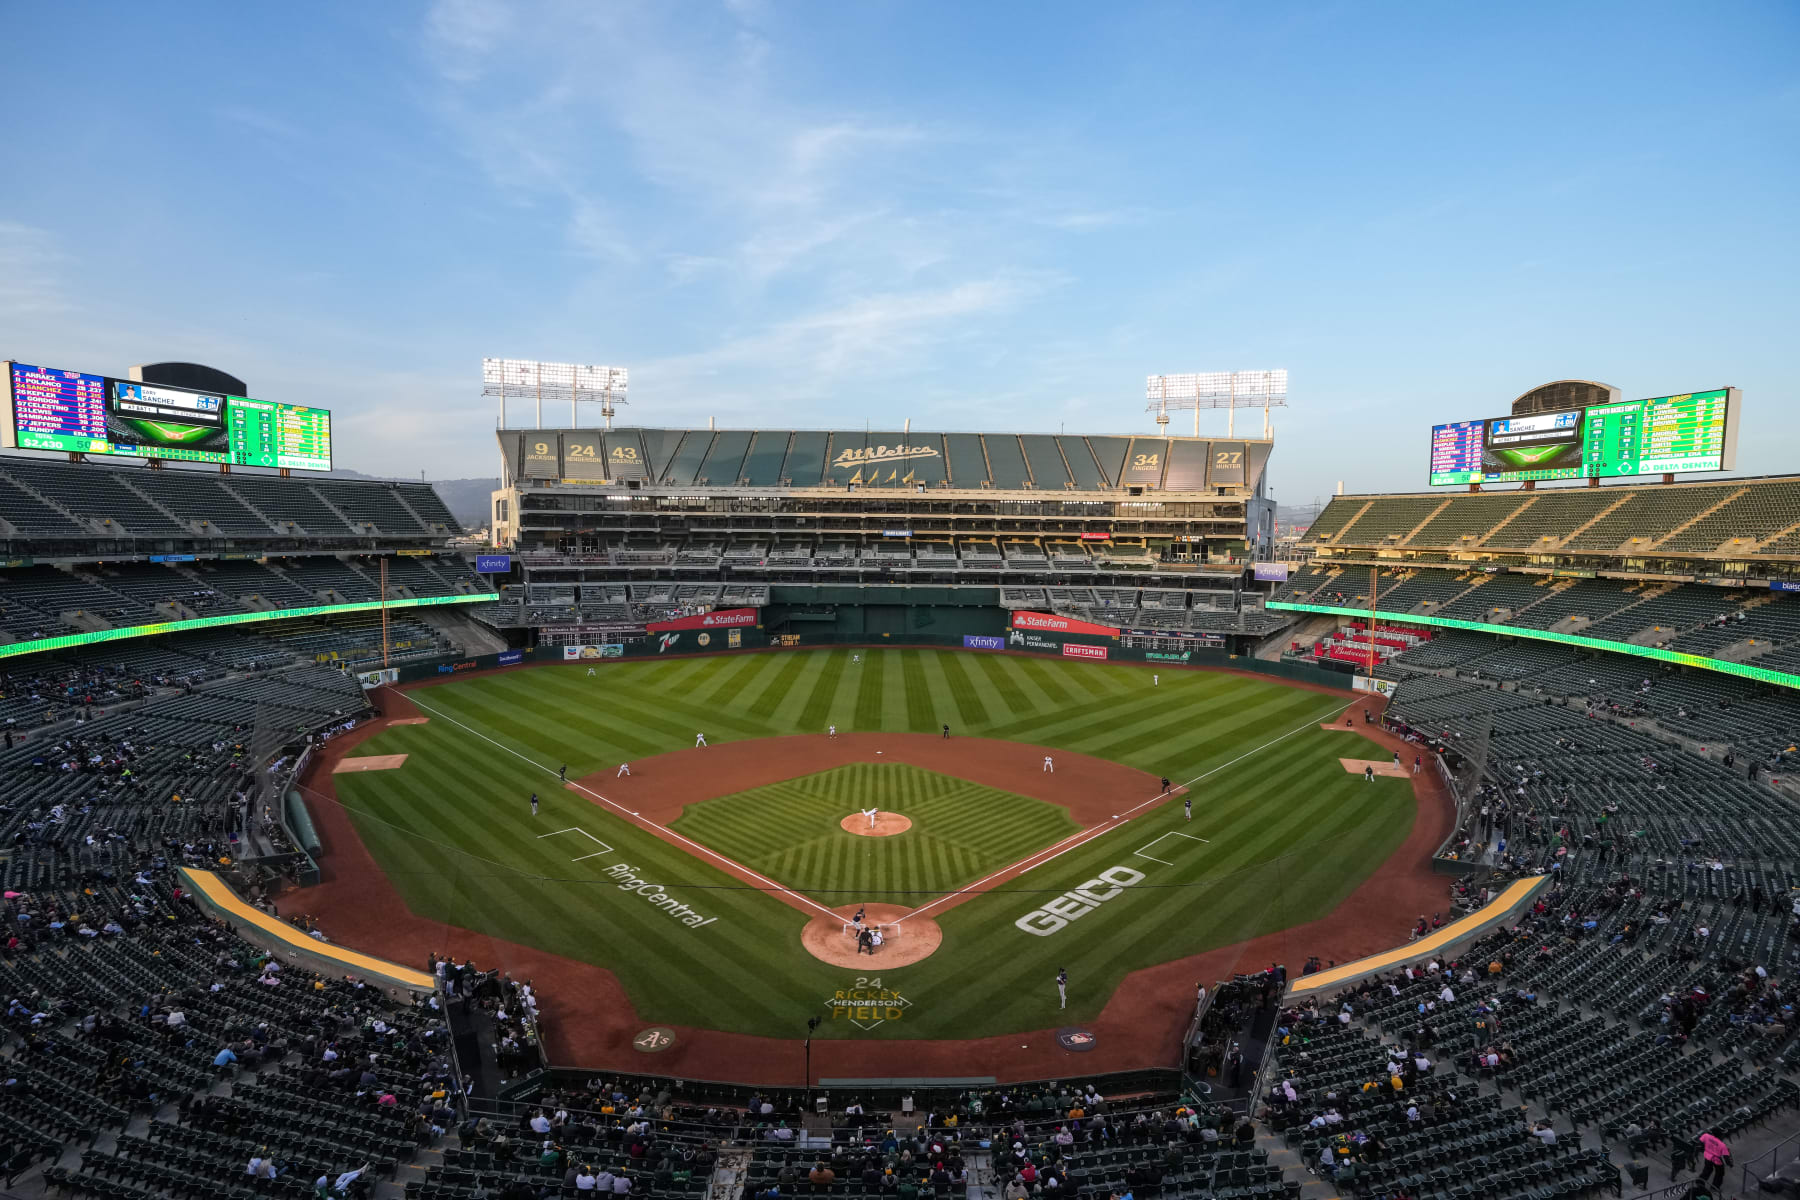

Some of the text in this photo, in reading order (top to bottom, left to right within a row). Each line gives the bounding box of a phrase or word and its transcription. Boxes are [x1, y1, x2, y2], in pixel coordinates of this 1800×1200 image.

[25, 378, 62, 387] POLANCO
[26, 384, 62, 393] SANCHEZ
[26, 390, 56, 398] KEPLER
[27, 396, 60, 404] GORDON
[142, 395, 175, 405] SANCHEZ
[27, 402, 69, 411] CELESTINO
[28, 407, 53, 415] LEWIS
[28, 414, 63, 422] MIRANDA
[29, 420, 62, 428] JEFFERS
[24, 438, 63, 449] $2,430
[535, 443, 548, 455] 9
[570, 444, 596, 457] 24
[612, 447, 637, 459] 43
[832, 444, 938, 468] Athletics
[1134, 454, 1159, 466] 34
[1216, 452, 1242, 463] 27
[1653, 460, 1719, 471] DELTA DENTAL
[480, 559, 506, 569] xfinity
[1258, 567, 1284, 577] xfinity
[969, 637, 998, 648] xfinity
[1065, 646, 1104, 656] CRAFTSMAN
[1334, 646, 1370, 659] Budweiser
[438, 660, 477, 672] RingCentral
[601, 863, 719, 929] RingCentral
[1015, 866, 1146, 936] GEICO
[855, 977, 882, 989] 24
[835, 990, 901, 1000] RICKEY
[832, 1006, 903, 1020] FIELD
[634, 1031, 670, 1048] A's
